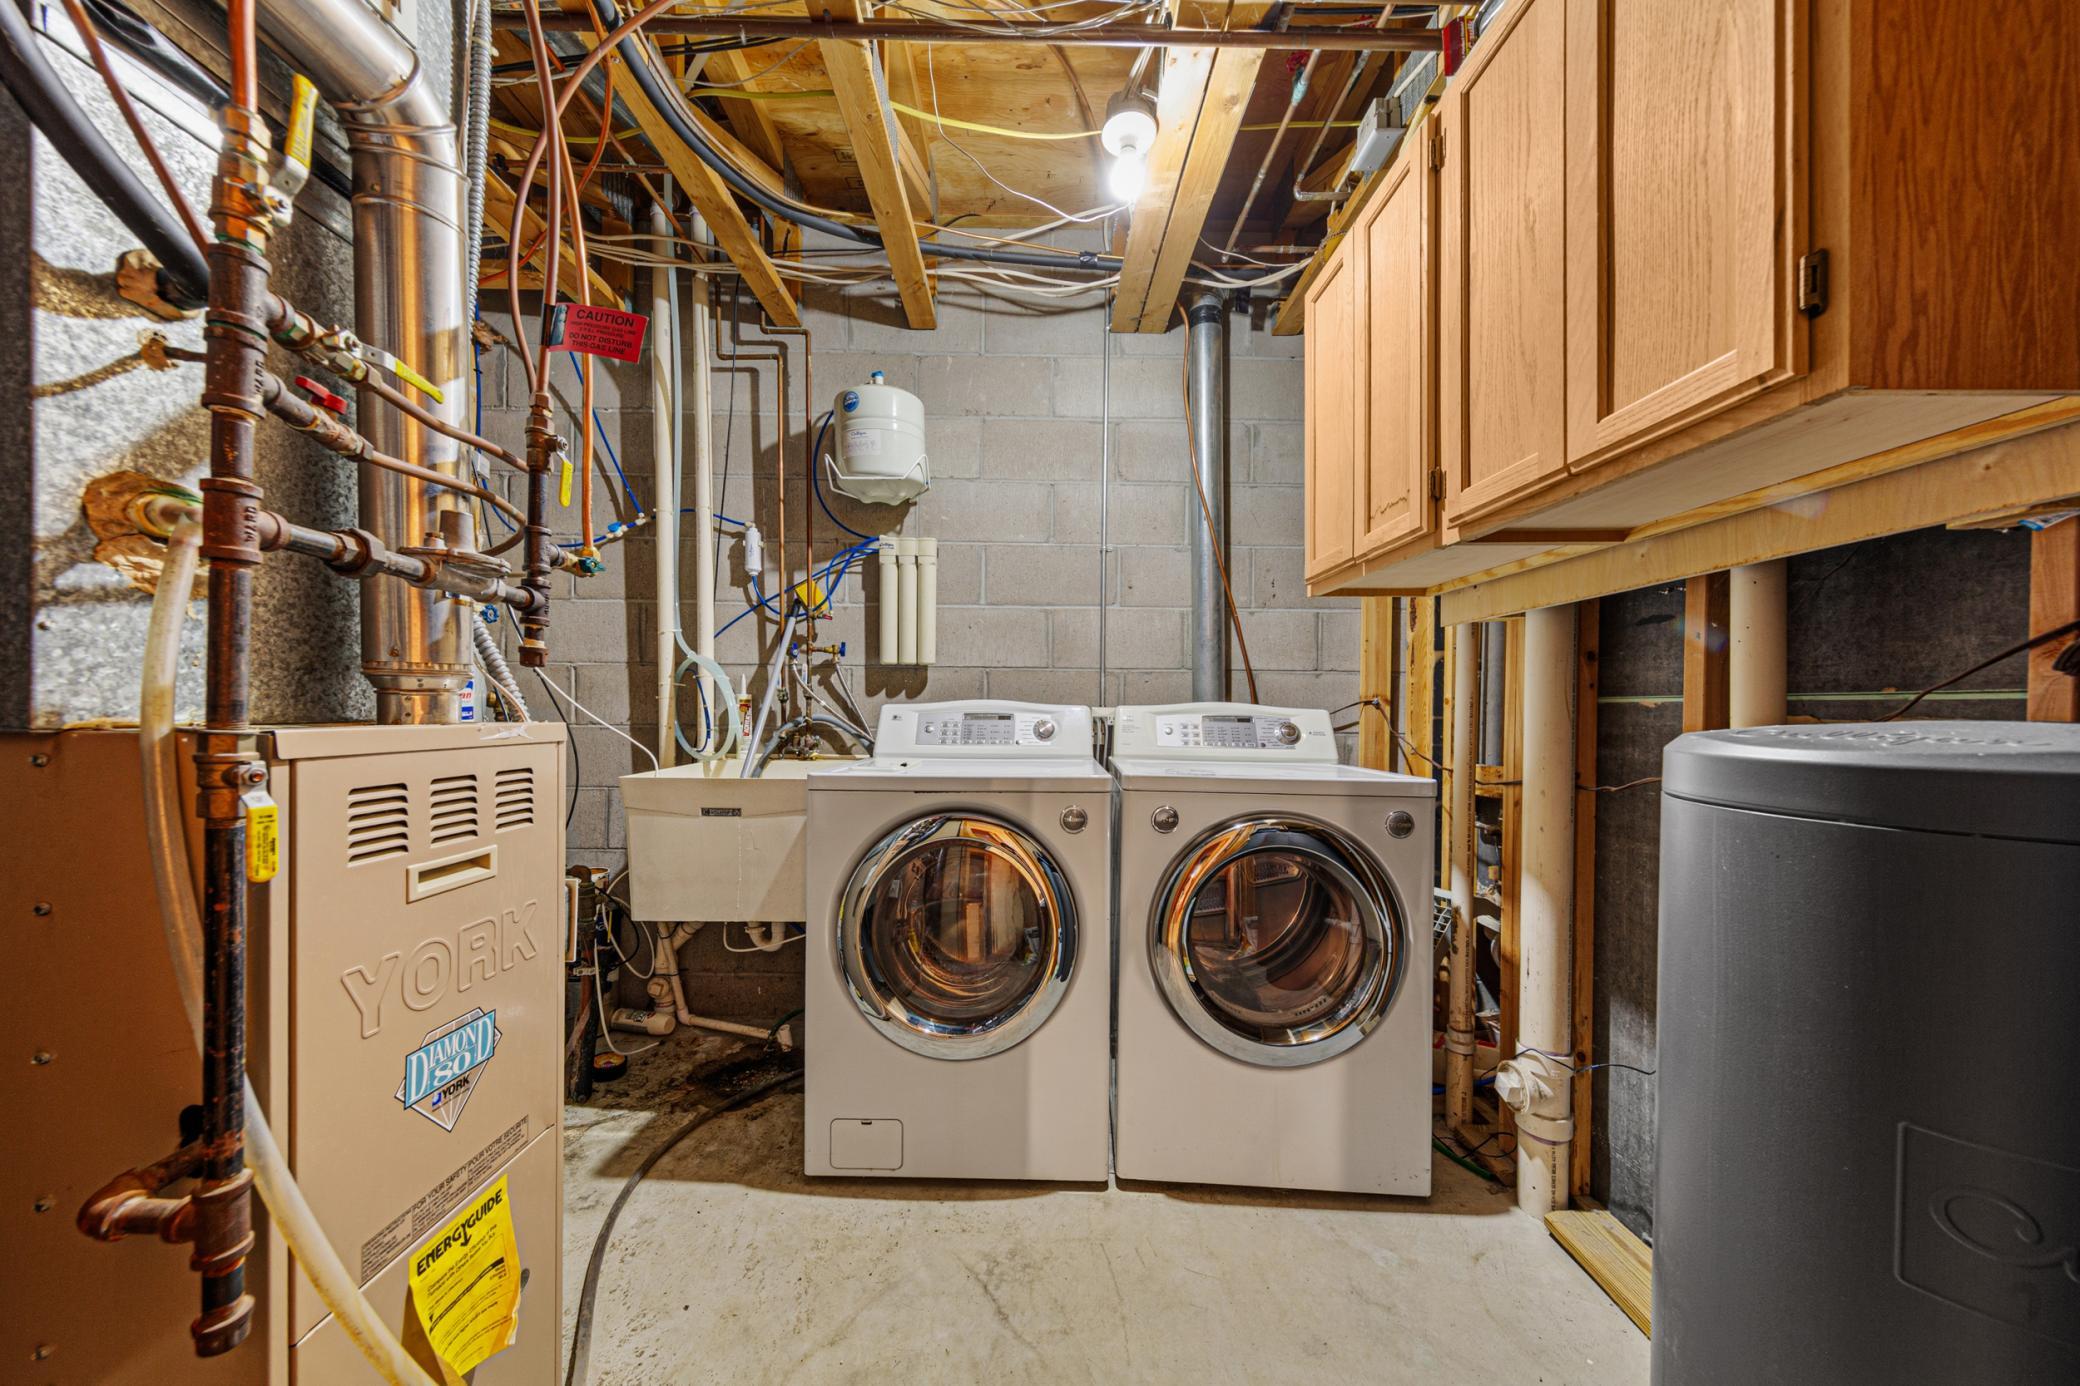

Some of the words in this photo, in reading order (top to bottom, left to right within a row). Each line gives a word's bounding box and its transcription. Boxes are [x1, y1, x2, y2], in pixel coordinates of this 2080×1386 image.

[577, 309, 634, 327] CAUTION
[581, 333, 597, 341] NOT
[598, 336, 633, 348] DISTURB
[608, 346, 626, 354] LINE
[244, 506, 257, 543] WARD
[340, 899, 538, 1040] YORK
[409, 1017, 493, 1103] DIAMOND
[433, 1051, 471, 1087] 80
[442, 1074, 471, 1099] YORK
[428, 1181, 445, 1199] YOUR
[445, 1165, 467, 1186] SAFETY
[416, 1189, 503, 1277] ENERGYGUIDE
